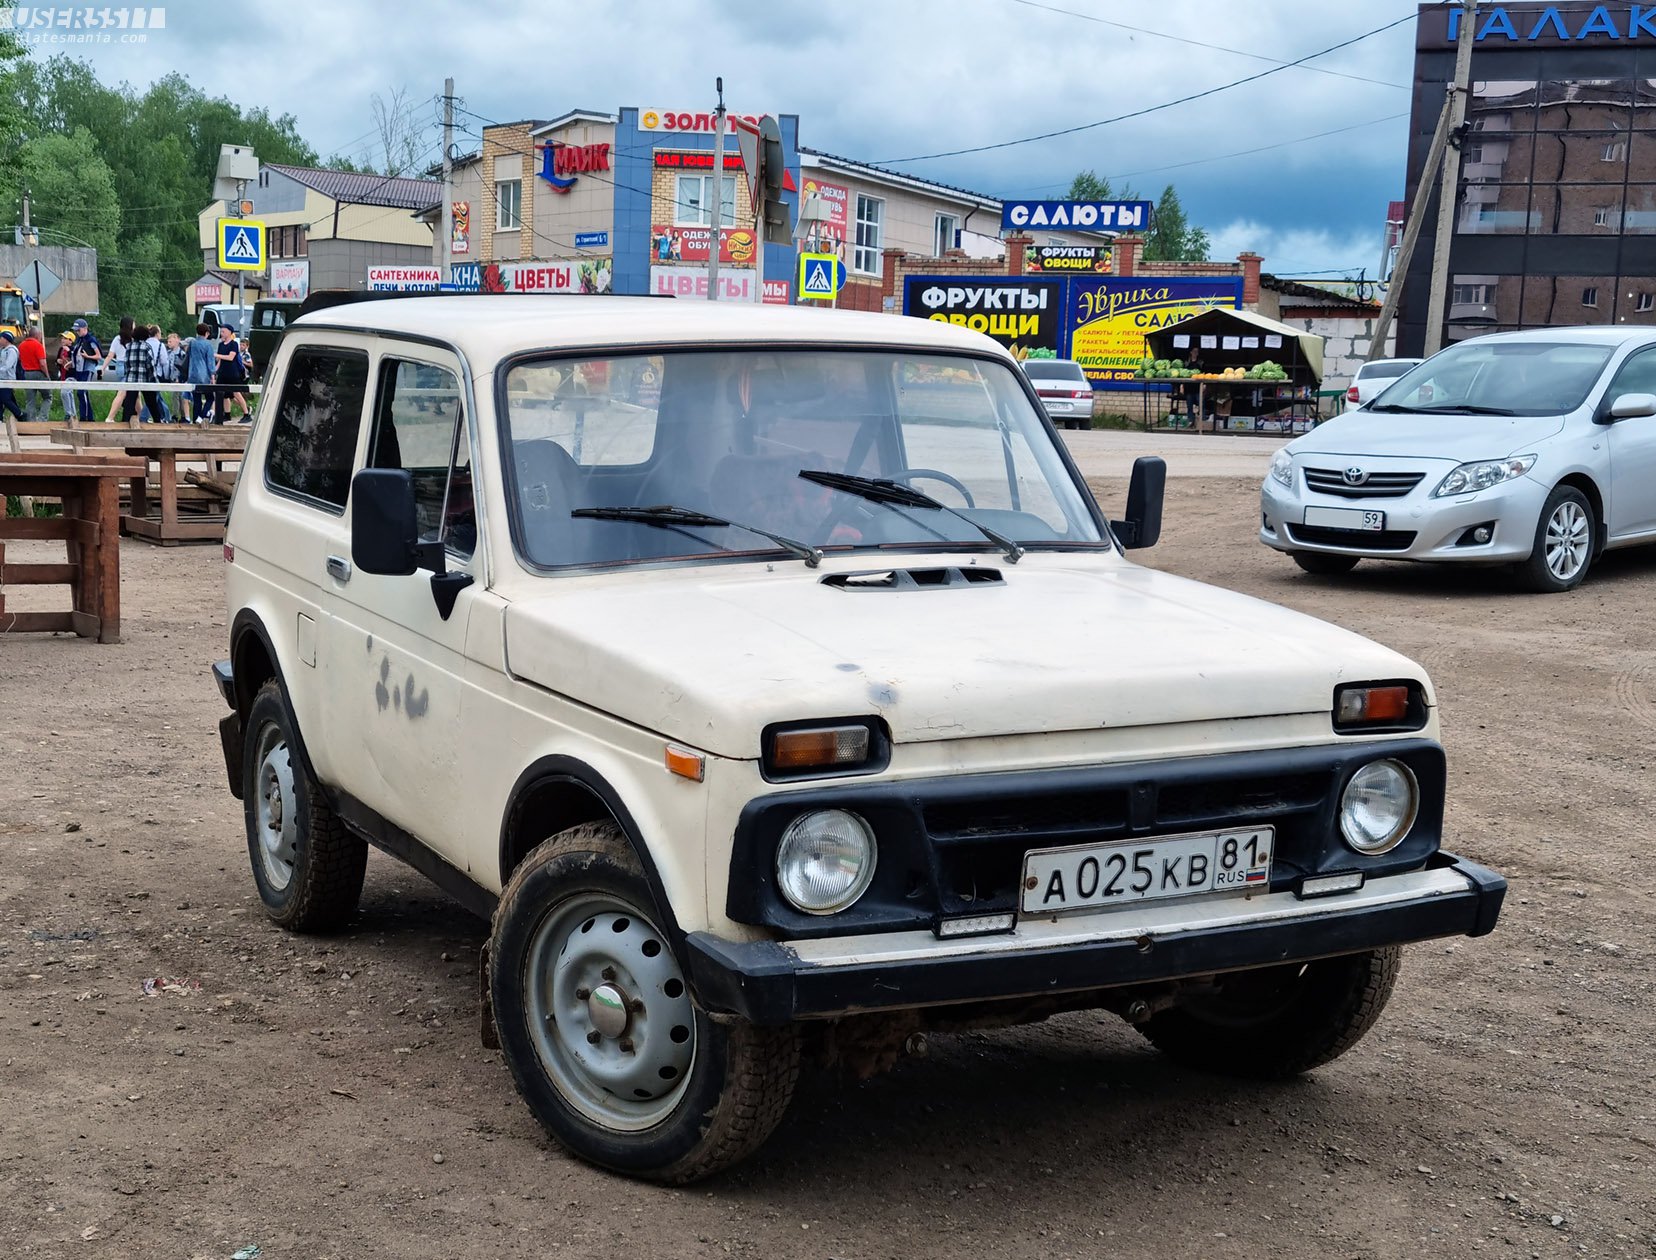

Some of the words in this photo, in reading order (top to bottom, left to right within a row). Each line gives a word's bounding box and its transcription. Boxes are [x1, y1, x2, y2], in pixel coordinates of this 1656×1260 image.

[555, 143, 610, 175] МАЯК
[820, 185, 847, 201] ОДЕЖДА
[1010, 205, 1142, 226] САЛЮТЫ
[682, 231, 727, 241] ОДЕЖА
[1041, 247, 1095, 258] ФРУКТЫ
[1043, 258, 1092, 269] ОВОЩИ
[370, 270, 439, 281] САНТЕХНИКА
[450, 265, 480, 286] КНА
[515, 268, 570, 292] ЦВЕТЫ
[197, 286, 220, 297] АРЕНДА
[921, 286, 1048, 309] ФРУКТЫ
[1077, 285, 1173, 323] Эврика
[1076, 356, 1141, 366] НАПОЛНЕНИЕ
[1364, 512, 1378, 525] 59
[1219, 835, 1259, 871] 81
[1216, 871, 1244, 885] RUS
